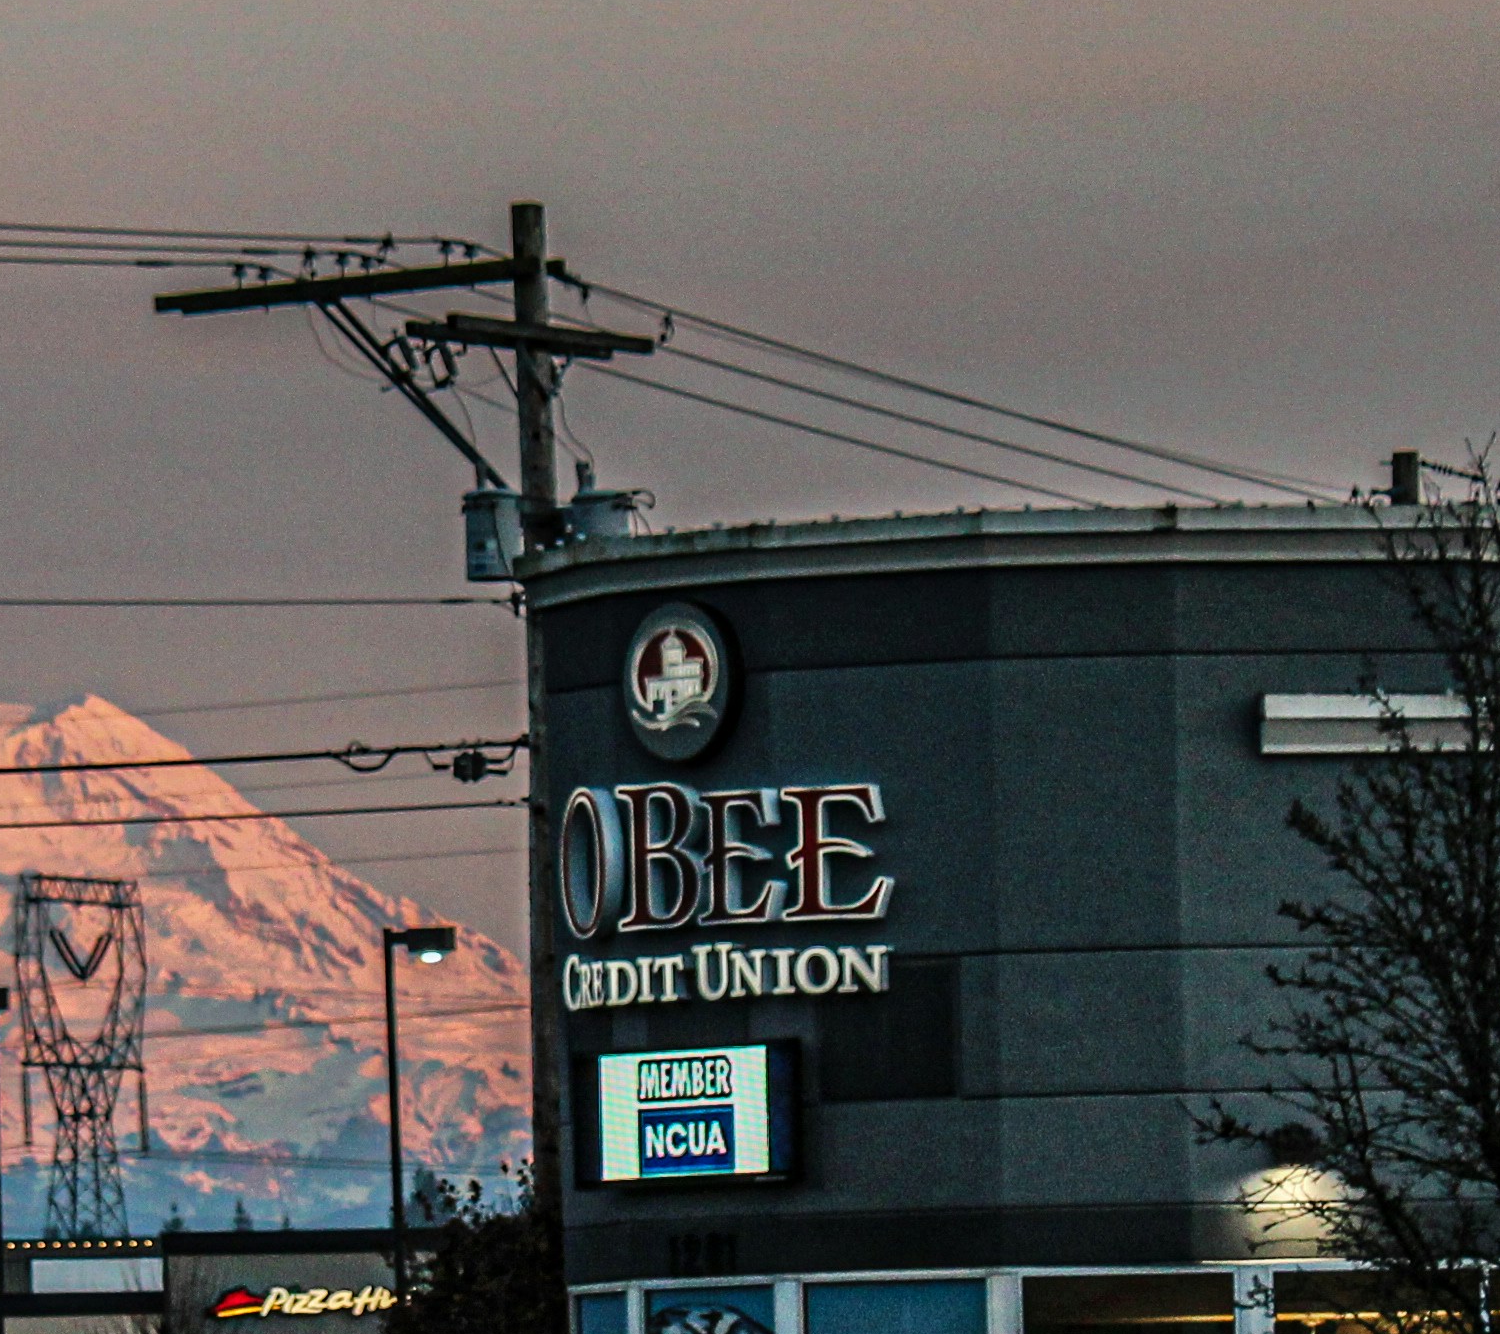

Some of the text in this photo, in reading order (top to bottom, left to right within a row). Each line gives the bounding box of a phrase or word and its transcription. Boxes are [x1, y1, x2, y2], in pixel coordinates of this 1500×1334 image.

[561, 781, 895, 939] OBEE
[563, 942, 891, 1011] CREDIT UNION
[638, 1056, 732, 1100] MEMBER
[644, 1120, 728, 1158] NCUA
